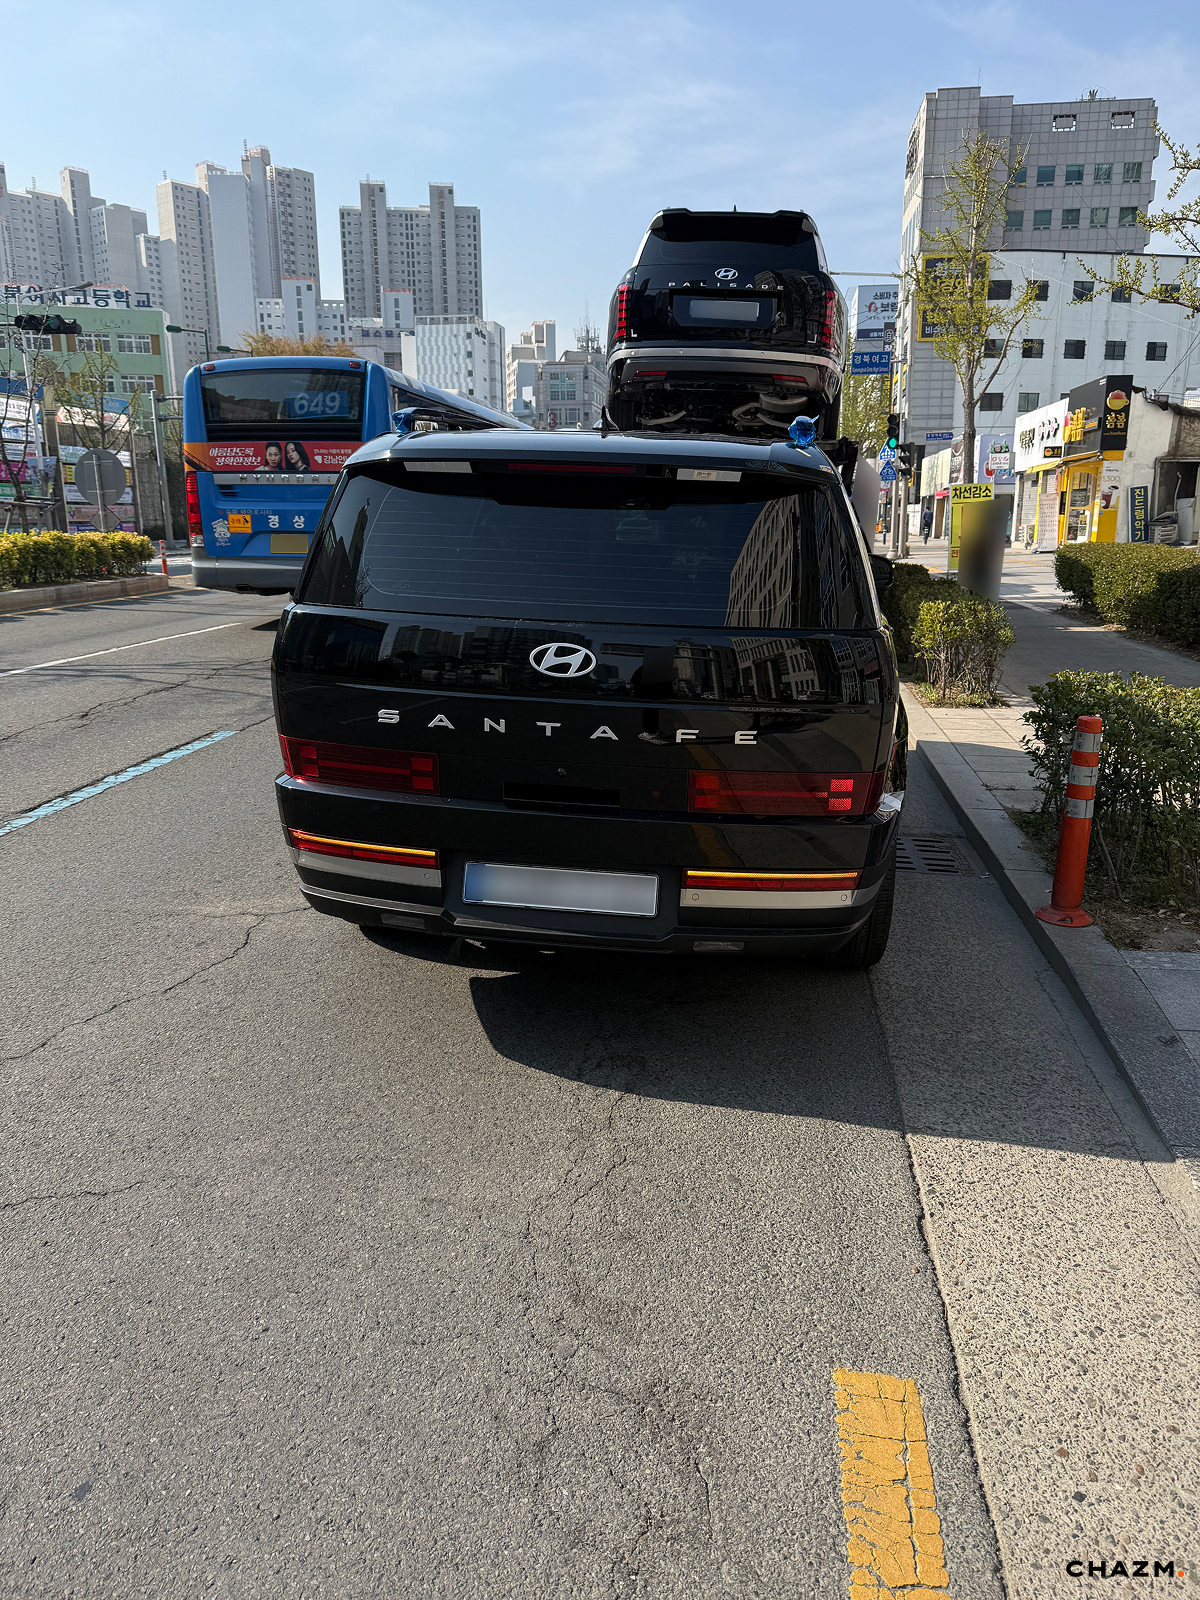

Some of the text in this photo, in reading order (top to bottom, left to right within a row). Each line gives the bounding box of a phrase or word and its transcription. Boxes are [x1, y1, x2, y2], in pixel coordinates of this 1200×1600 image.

[668, 281, 784, 291] PALISADE
[854, 354, 888, 364] 경북여고
[294, 391, 341, 415] 649
[323, 455, 347, 464] 강남언
[239, 474, 331, 483] HYUNDAI
[952, 486, 992, 499] 차선감소
[1134, 488, 1145, 541] 진드럼악기
[377, 709, 758, 745] SANTA FE
